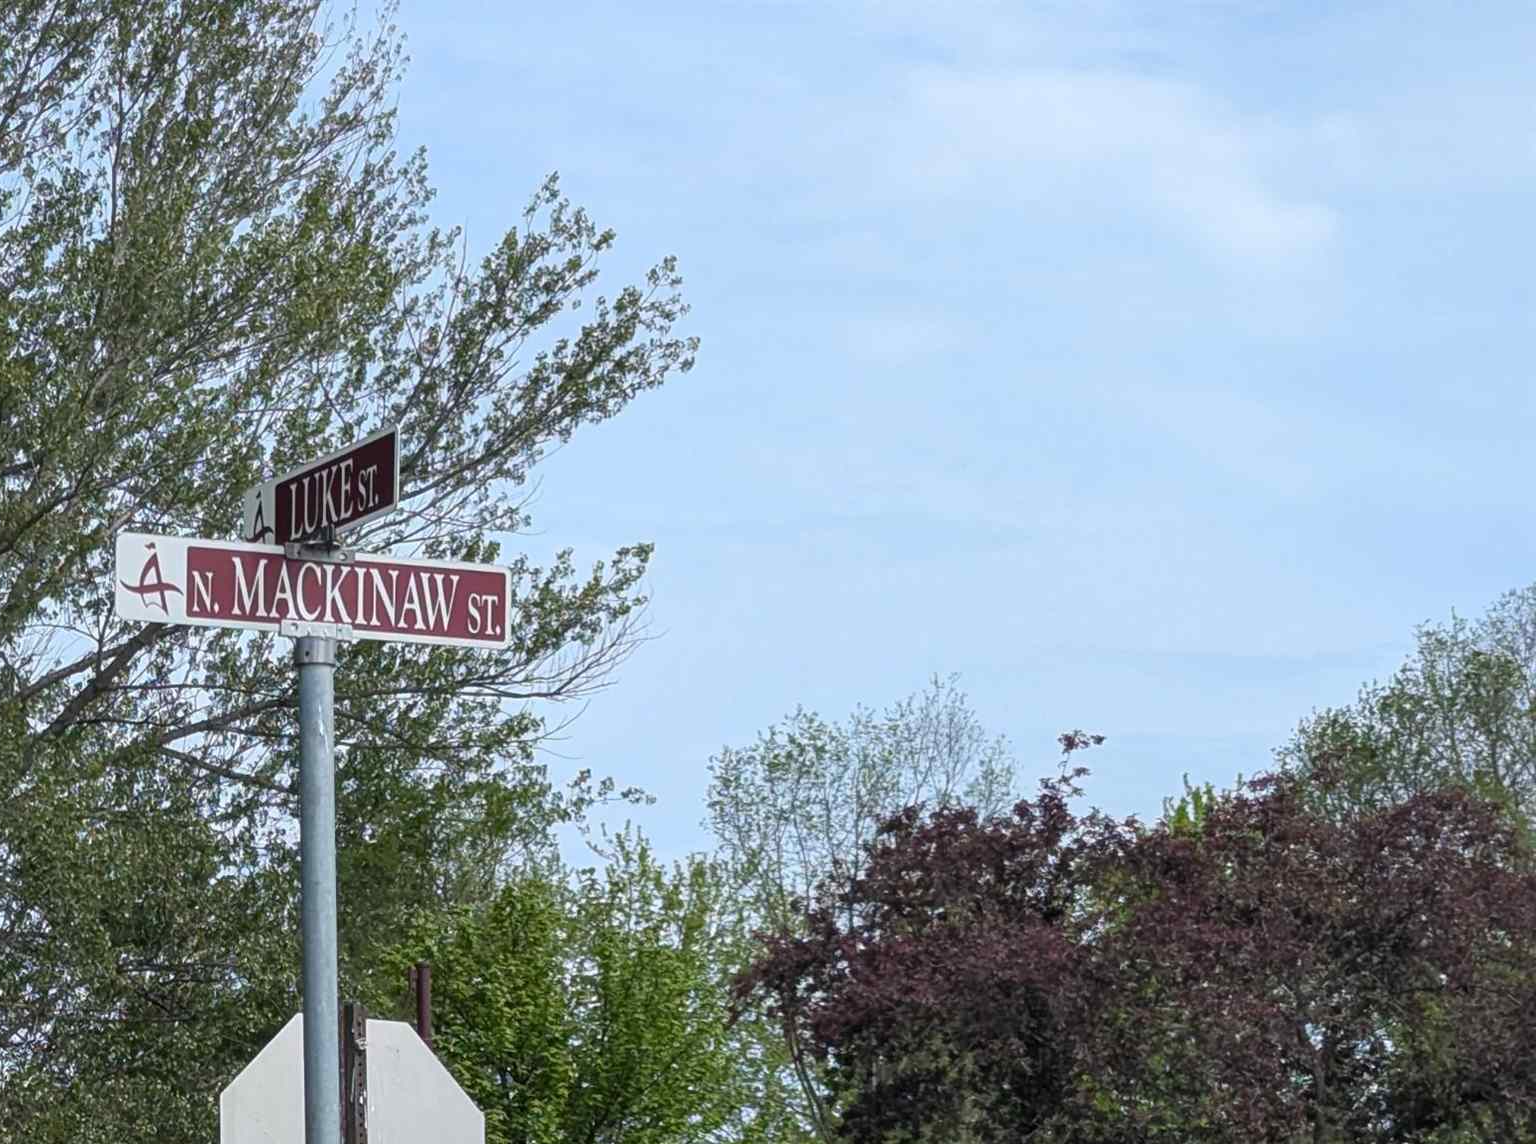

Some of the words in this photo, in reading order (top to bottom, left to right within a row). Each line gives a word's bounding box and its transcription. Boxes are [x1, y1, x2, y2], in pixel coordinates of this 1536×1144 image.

[289, 458, 353, 541] LUKE
[357, 464, 379, 511] ST.
[192, 571, 219, 614] N.
[231, 556, 460, 631] MACKINAW
[467, 593, 502, 636] ST.
